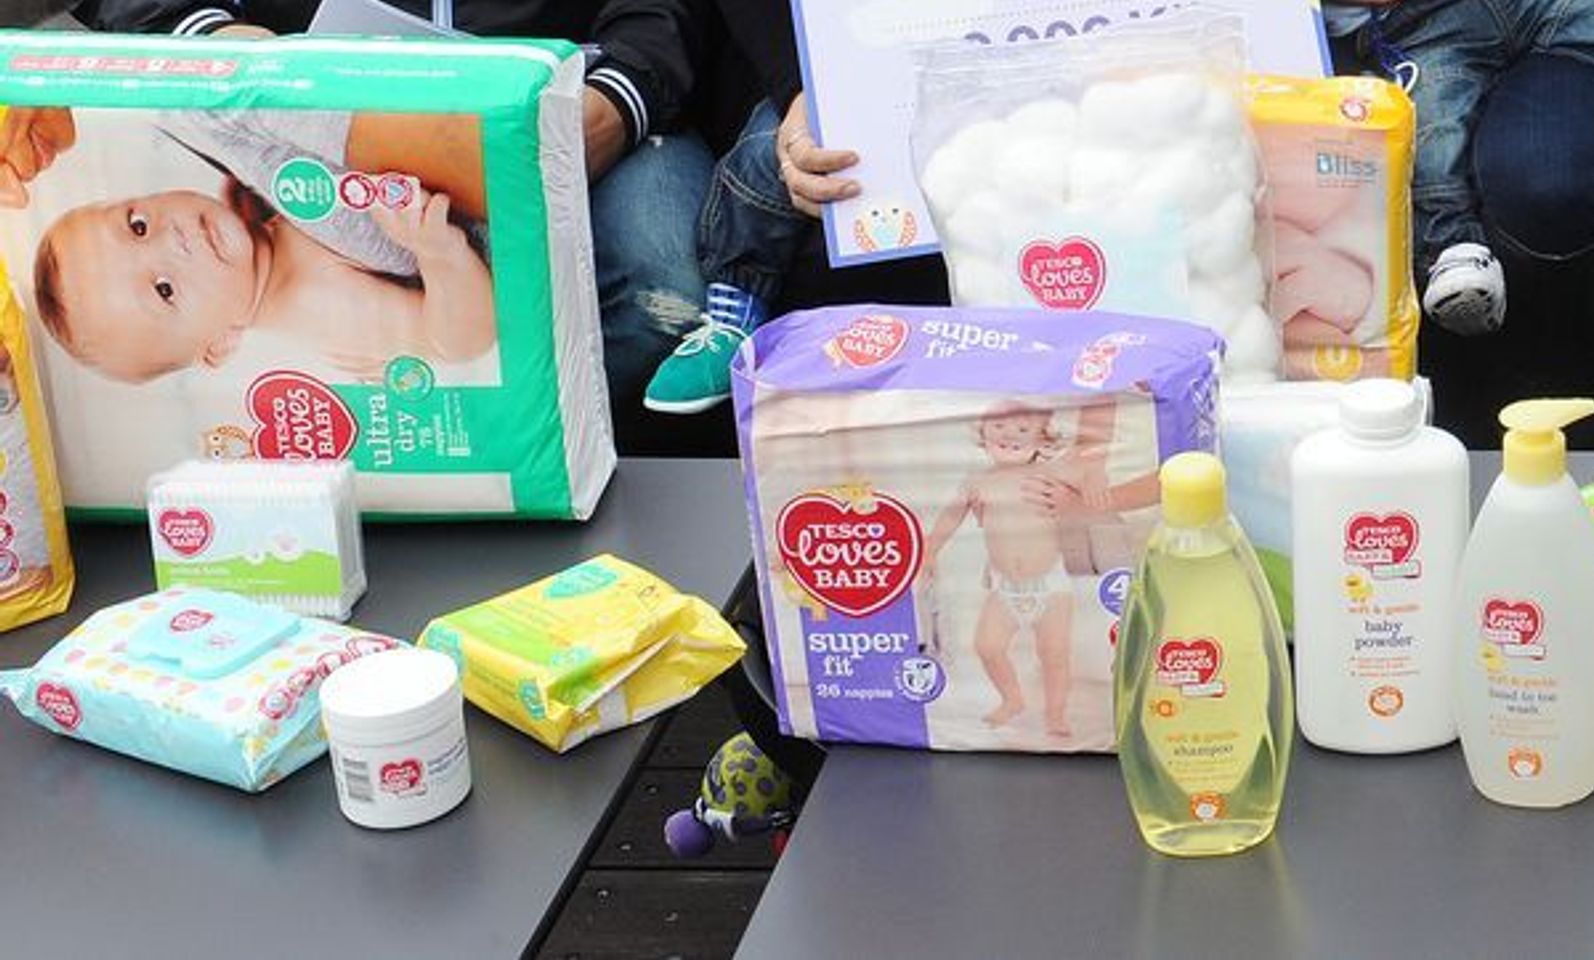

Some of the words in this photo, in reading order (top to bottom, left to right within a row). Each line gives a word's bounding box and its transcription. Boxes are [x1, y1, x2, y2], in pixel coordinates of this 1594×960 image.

[278, 177, 307, 203] 2
[921, 319, 1019, 351] super
[925, 340, 959, 359] fit
[272, 397, 291, 454] TESCO
[313, 397, 335, 456] BABY
[367, 393, 393, 468] ultra
[395, 411, 419, 452] dry
[808, 524, 886, 539] TESCO
[799, 529, 902, 566] loves
[813, 569, 891, 588] BABY
[1365, 620, 1403, 639] baby
[808, 632, 909, 659] super
[824, 655, 854, 677] fit
[1174, 743, 1233, 758] shampoo
